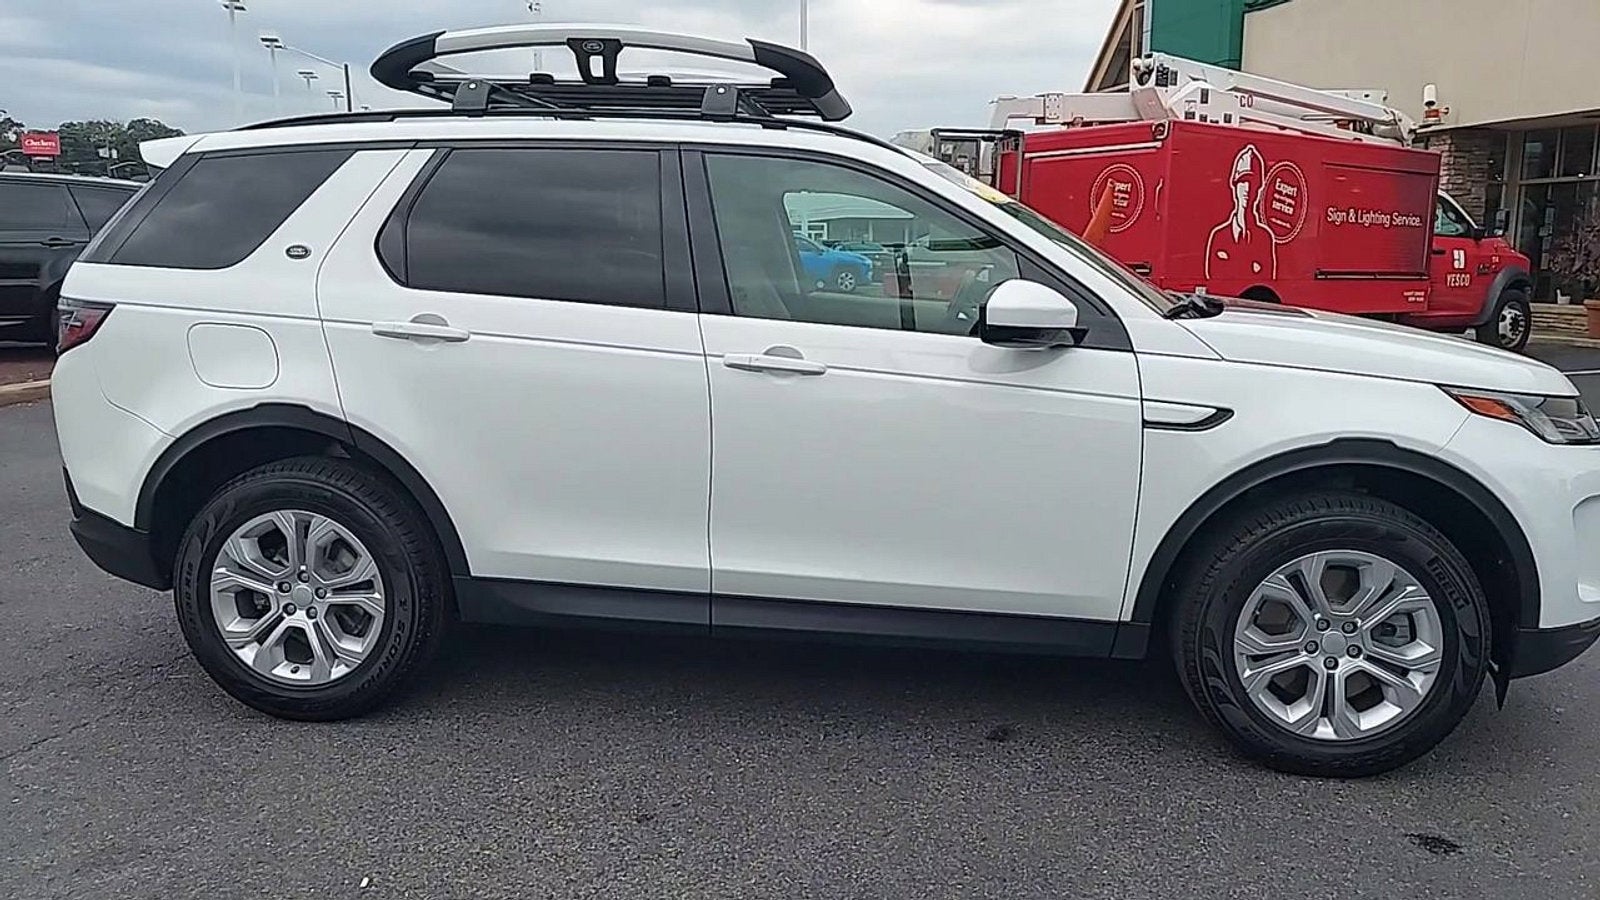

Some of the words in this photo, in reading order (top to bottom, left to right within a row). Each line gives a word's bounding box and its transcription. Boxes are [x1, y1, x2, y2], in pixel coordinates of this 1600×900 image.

[1275, 177, 1298, 198] Expert
[1327, 207, 1347, 226] Sign
[1347, 208, 1357, 223] &
[1357, 209, 1391, 228] Lighting
[1446, 273, 1471, 288] YESCO
